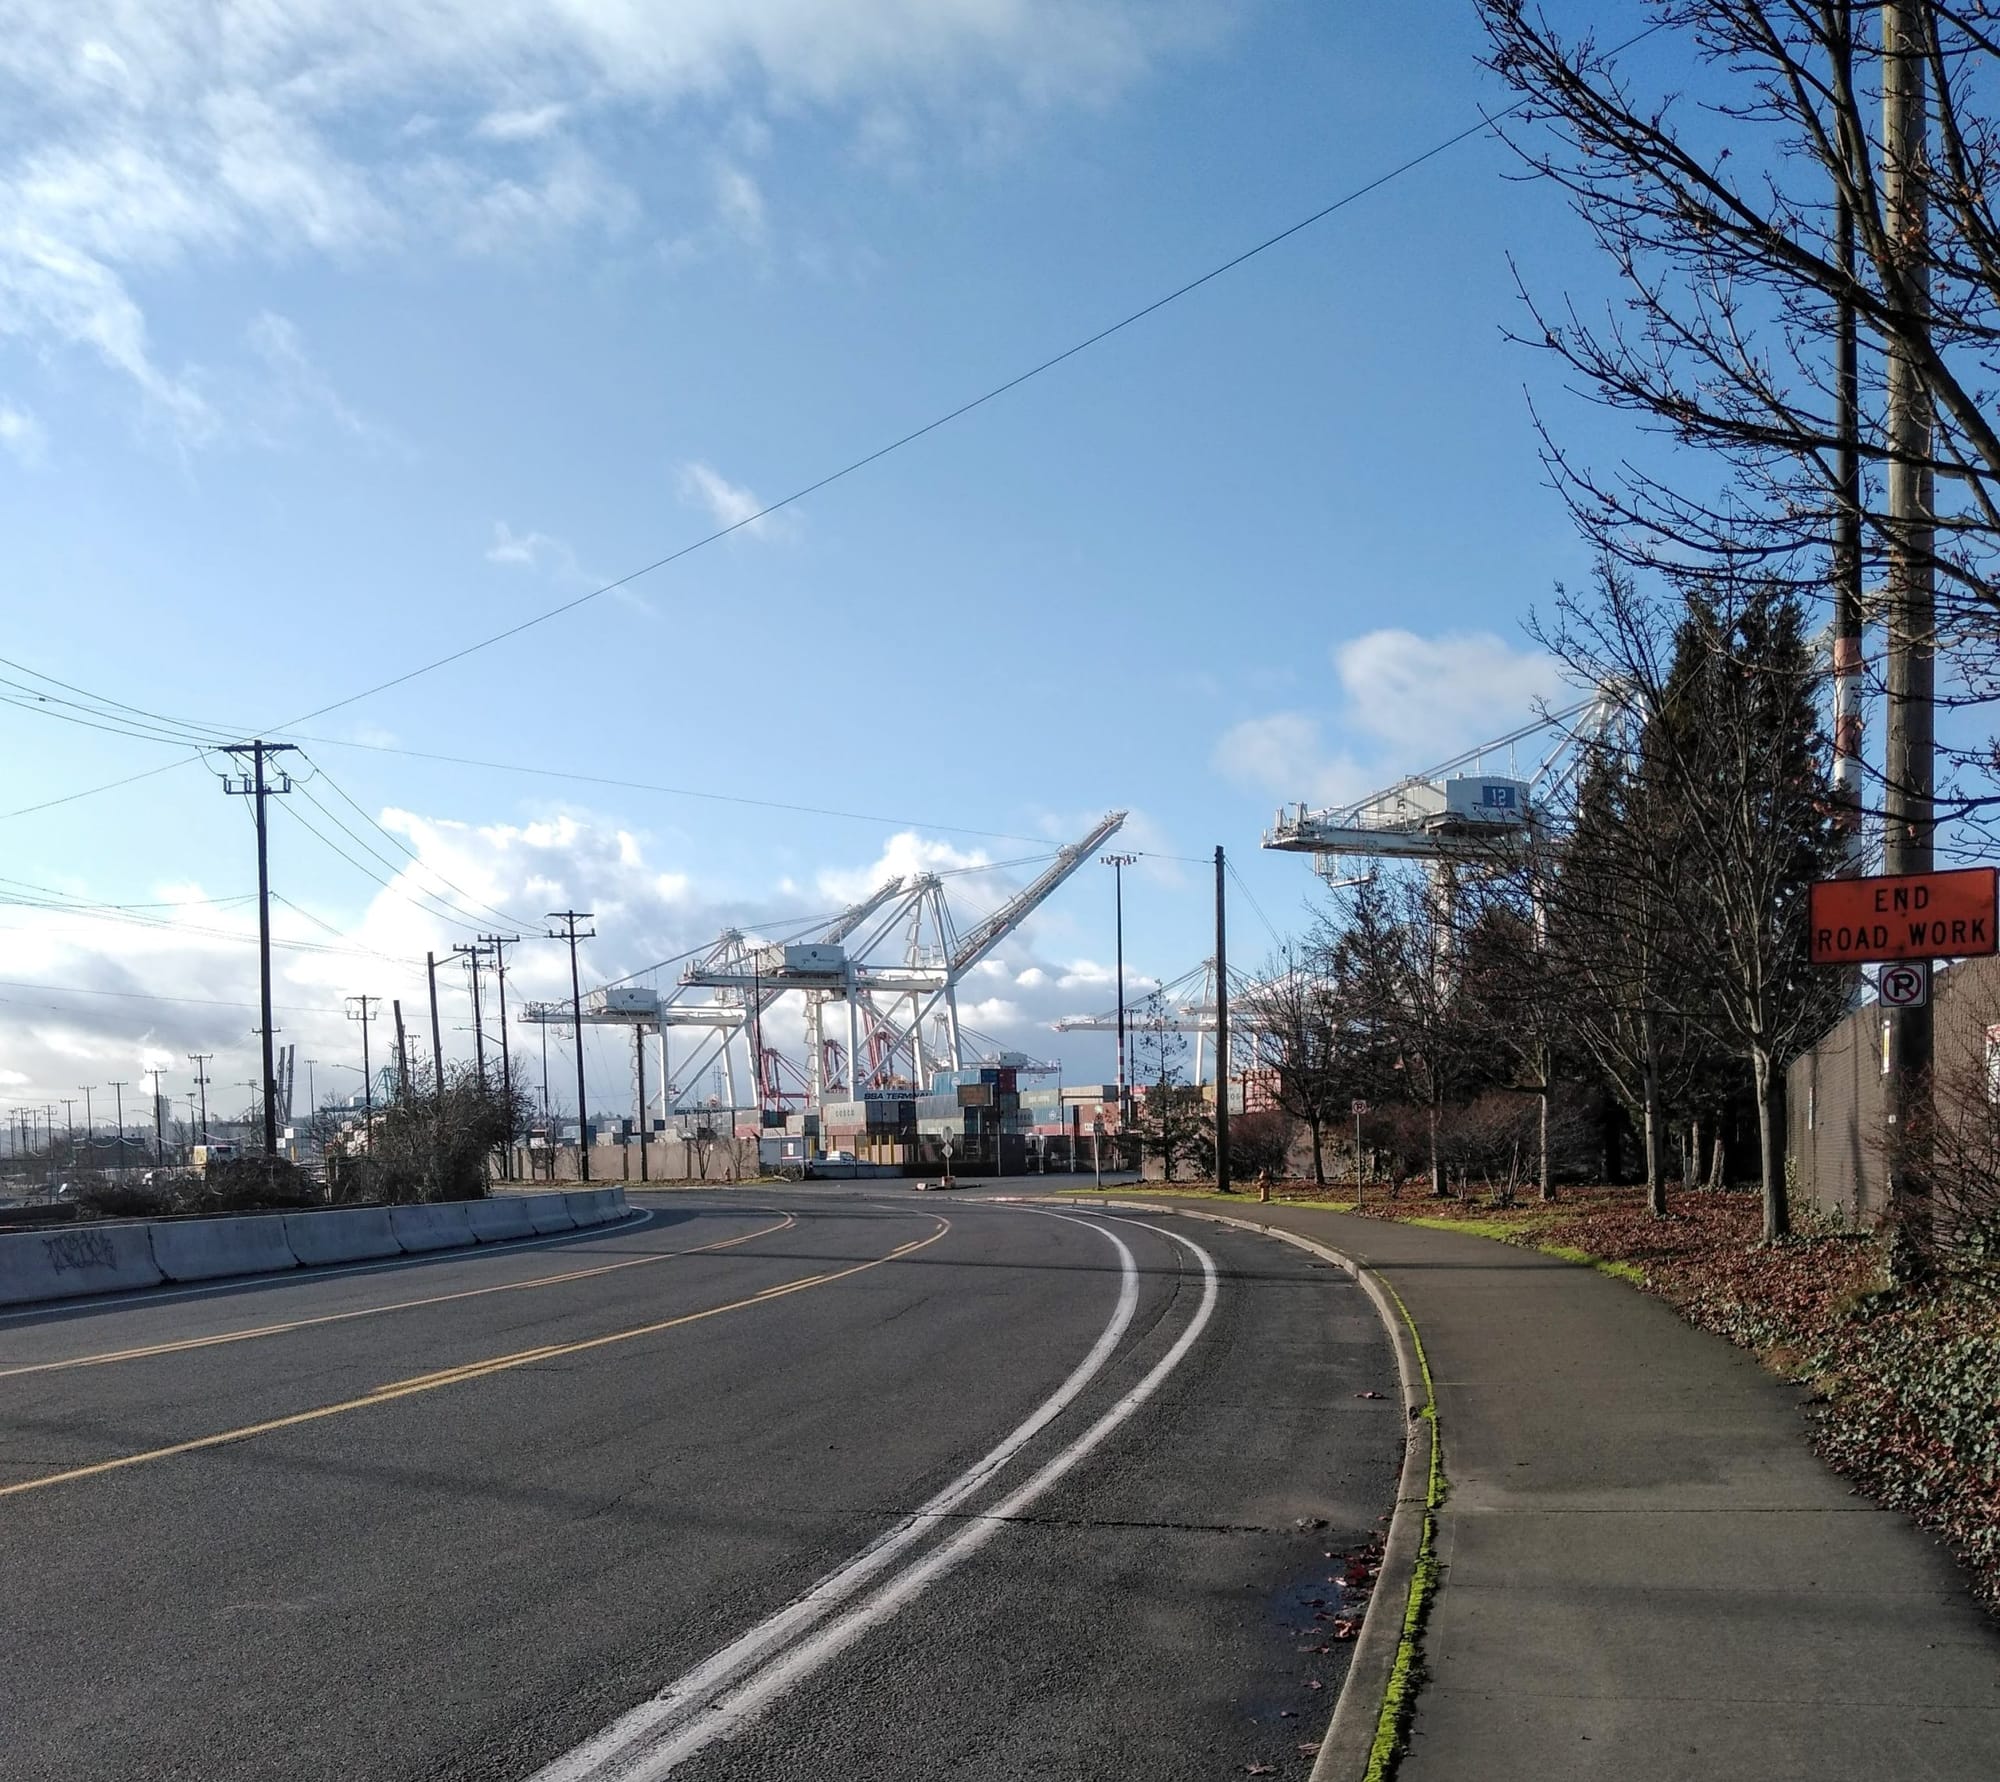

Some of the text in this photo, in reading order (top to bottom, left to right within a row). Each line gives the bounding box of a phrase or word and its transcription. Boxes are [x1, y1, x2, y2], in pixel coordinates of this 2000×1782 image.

[1875, 886, 1928, 912] END
[1818, 919, 1985, 952] ROAD WORK
